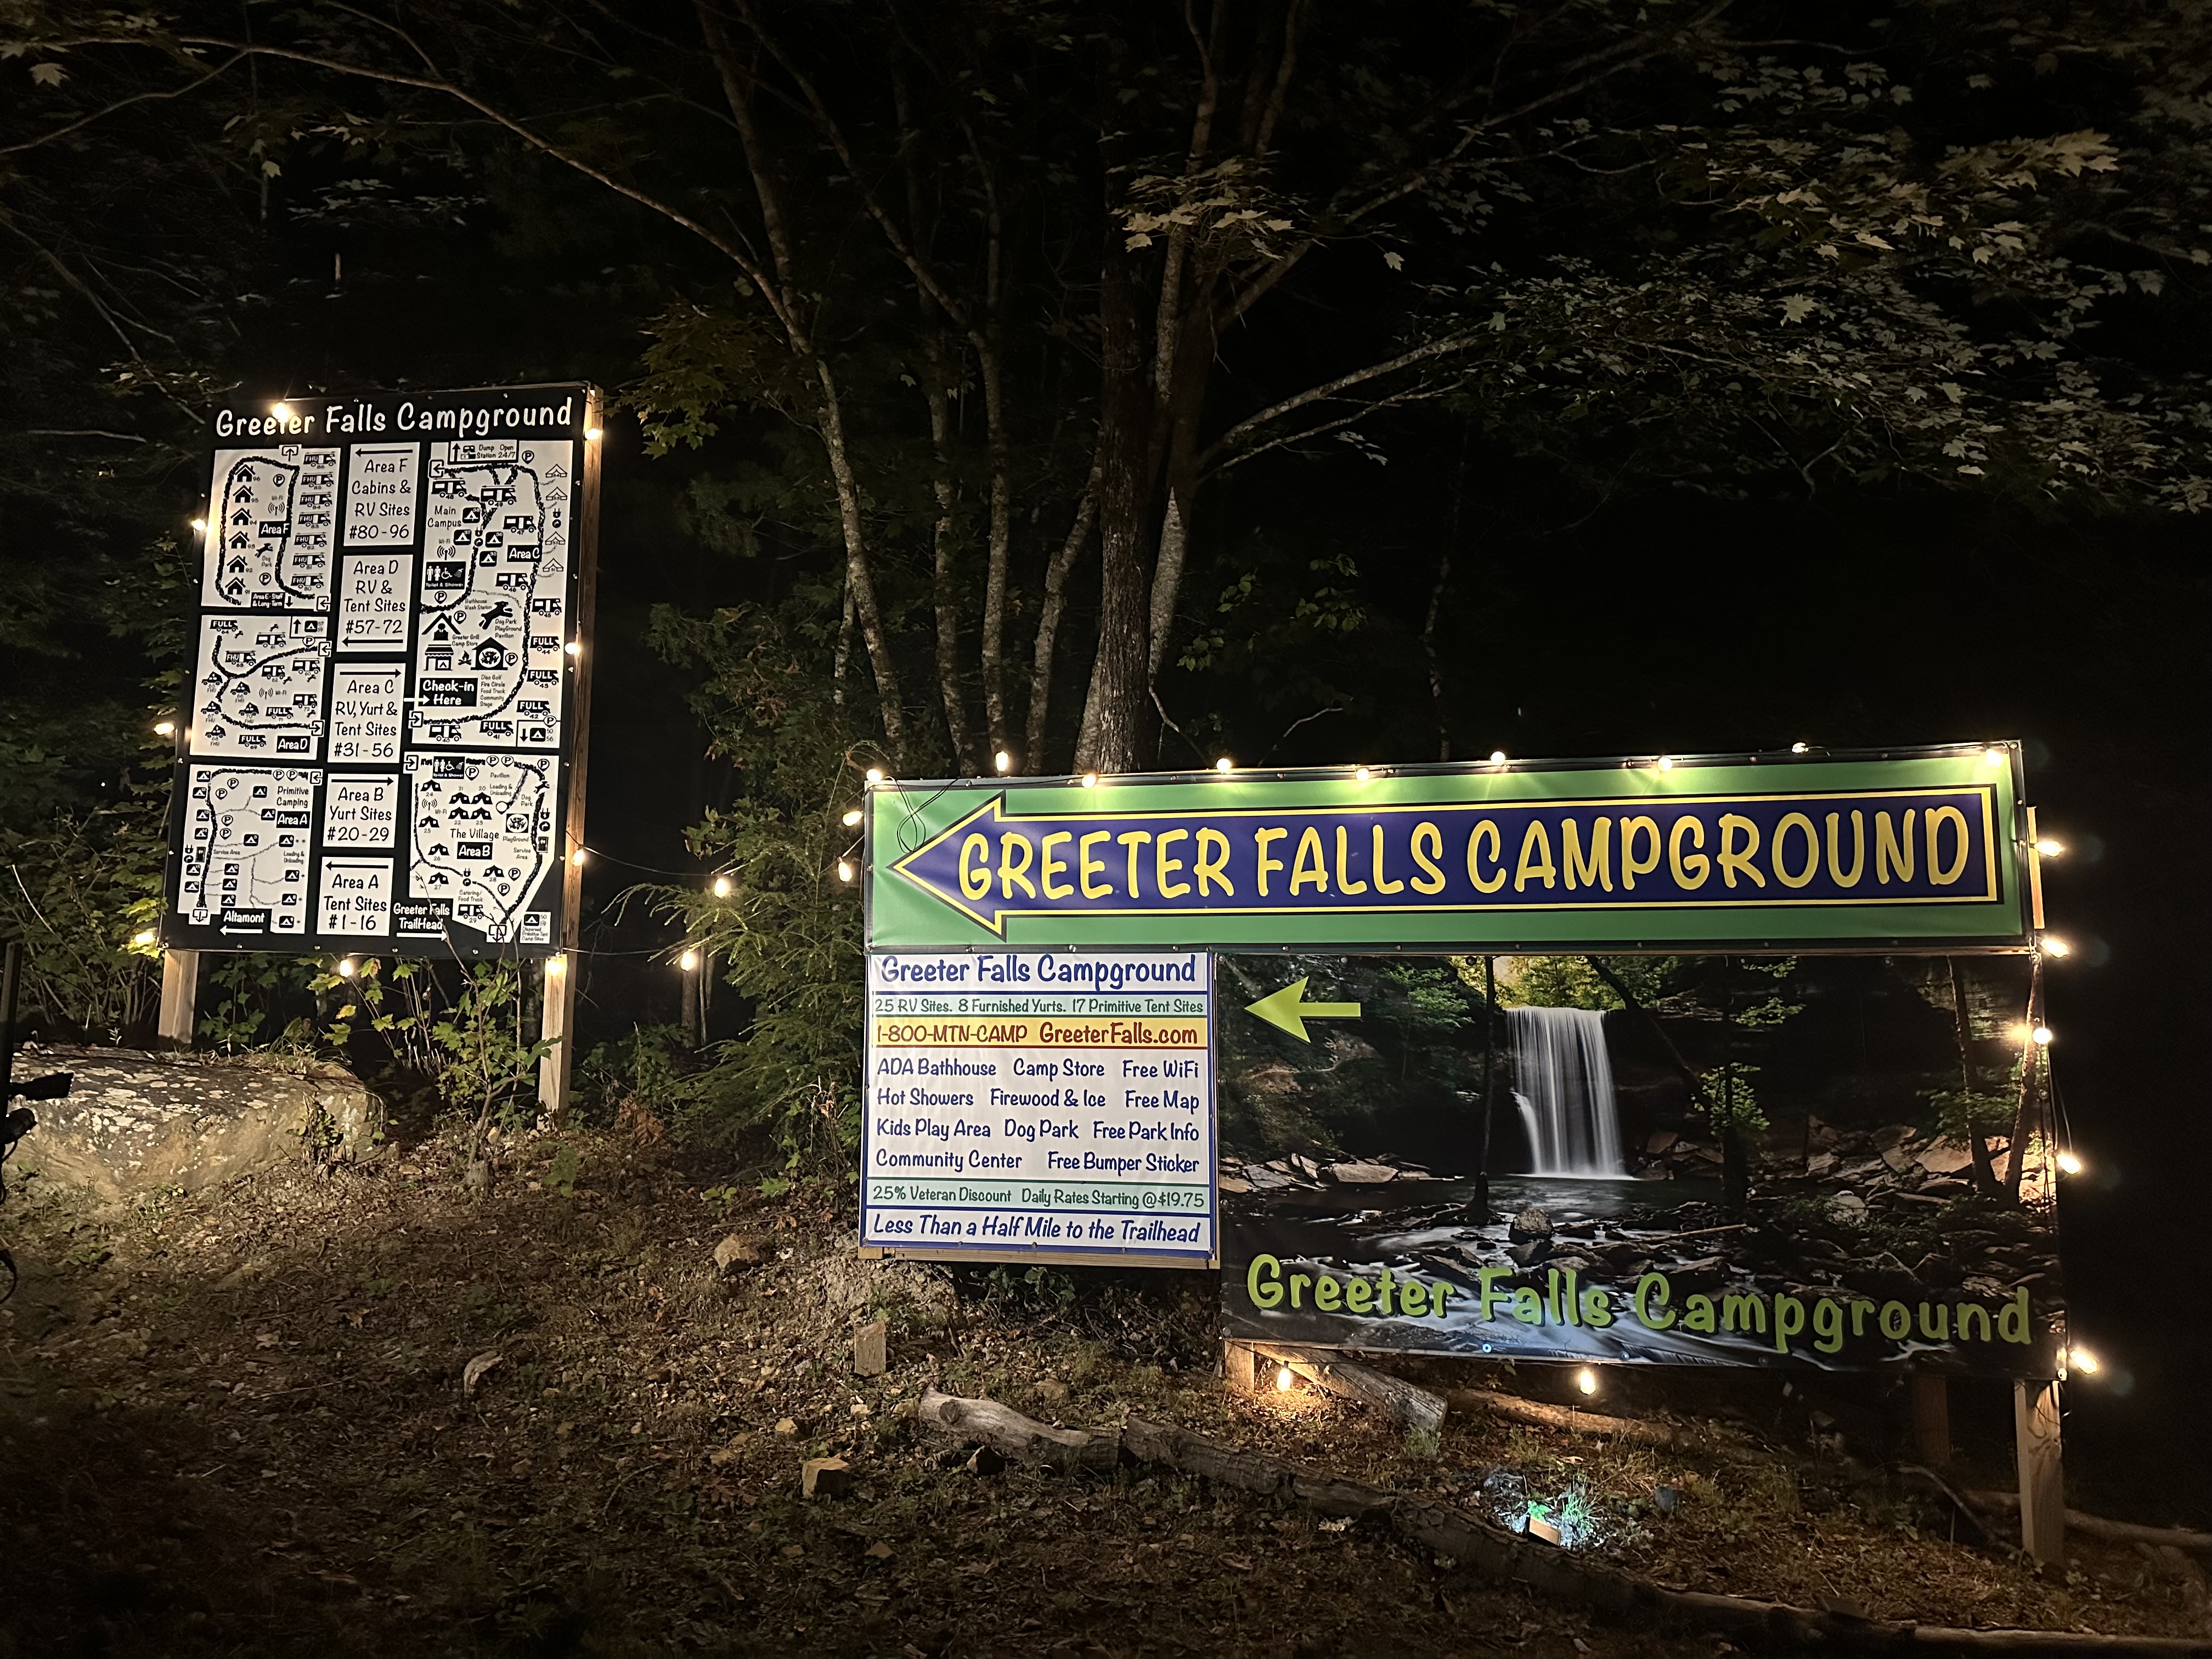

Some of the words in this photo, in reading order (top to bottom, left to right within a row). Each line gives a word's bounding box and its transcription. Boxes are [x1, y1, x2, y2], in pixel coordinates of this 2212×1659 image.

[326, 403, 386, 433] Falls
[397, 397, 572, 437] Campground
[364, 459, 394, 473] Area
[399, 458, 408, 472] F
[352, 479, 396, 494] Cabins
[400, 479, 411, 493] &
[354, 502, 375, 516] RV
[379, 502, 409, 516] Sites
[435, 505, 455, 515] Main
[261, 523, 281, 534] Area
[283, 523, 289, 534] F
[427, 518, 461, 530] Campus
[509, 548, 531, 558] Area
[532, 549, 540, 558] C
[353, 561, 384, 574] Area
[389, 560, 398, 574] D
[356, 579, 377, 594] RV
[381, 580, 392, 594] &
[344, 599, 370, 612] Tent
[374, 598, 405, 612] Sites
[347, 680, 379, 694] Area
[385, 679, 394, 693] C
[422, 680, 474, 692] Check-in
[433, 693, 462, 706] Here
[335, 701, 357, 718] RV,
[359, 702, 383, 715] Yurt
[386, 702, 397, 715] &
[335, 722, 362, 736] Tent
[365, 721, 397, 736] Sites
[278, 738, 298, 750] Area
[300, 738, 307, 749] D
[278, 786, 308, 794] Primitive
[338, 787, 369, 802] Area
[374, 787, 383, 801] B
[276, 797, 308, 808] Camping
[278, 814, 298, 825] Area
[300, 814, 307, 825] A
[330, 805, 356, 820] Yurt
[360, 806, 392, 820] Sites
[450, 828, 466, 838] The
[469, 828, 499, 841] Village
[459, 845, 481, 856] Area
[482, 845, 490, 856] B
[959, 827, 1234, 901] GREETER
[1255, 821, 1447, 897] FALLS
[1466, 805, 1970, 894] CAMPGROUND
[332, 873, 363, 889] Area
[368, 874, 379, 889] A
[324, 895, 351, 911] Tent
[355, 895, 387, 912] Sites
[393, 902, 427, 916] Greeter
[429, 903, 450, 916] Falls
[223, 910, 265, 923] Altamont
[399, 917, 443, 930] TrailHead
[881, 955, 970, 983] Greeter
[978, 954, 1030, 983] Falls
[1037, 953, 1195, 991] Campground
[875, 998, 894, 1012] 25
[898, 998, 918, 1012] RV
[921, 998, 952, 1012] Sites.
[958, 998, 969, 1012] 8
[972, 998, 1029, 1013] Furnished
[1032, 999, 1066, 1013] Yurts.
[1073, 998, 1086, 1013] 17
[1089, 998, 1142, 1013] Primitive
[1144, 999, 1170, 1012] Tent
[1173, 998, 1203, 1013] Sites
[877, 1024, 1028, 1042] 1-800-MTN-CAMP
[1039, 1022, 1198, 1044] GreeterFalls.com
[877, 1058, 913, 1075] ADA
[918, 1058, 996, 1076] Bathhouse
[1013, 1058, 1058, 1082] Camp
[1063, 1058, 1104, 1076] Store
[1122, 1059, 1158, 1077] Free
[1163, 1059, 1198, 1078] WiFi
[877, 1087, 905, 1105] Hot
[910, 1087, 974, 1105] Showers
[990, 1088, 1059, 1107] Firewood
[1064, 1088, 1079, 1107] &
[1084, 1089, 1105, 1107] Ice
[1125, 1090, 1159, 1108] Free
[1163, 1090, 1199, 1115] Map
[877, 1118, 911, 1136] Kids
[915, 1118, 949, 1141] Play
[953, 1119, 991, 1137] Area
[1005, 1119, 1035, 1142] Dog
[1040, 1119, 1079, 1139] Park
[1093, 1120, 1125, 1139] Free
[1129, 1121, 1167, 1141] Park
[1171, 1122, 1199, 1141] Info
[876, 1148, 963, 1172] Community
[968, 1149, 1022, 1169] Center
[1048, 1151, 1080, 1169] Free
[1084, 1152, 1142, 1177] Bumper
[1146, 1153, 1200, 1173] Sticker
[873, 1186, 906, 1200] 25%
[910, 1186, 956, 1201] Veteran
[960, 1187, 1012, 1202] Discount
[1022, 1188, 1051, 1207] Daily
[1053, 1188, 1089, 1204] Rates
[1092, 1189, 1139, 1209] Starting
[873, 1213, 913, 1234] Less
[919, 1214, 962, 1235] Than
[966, 1222, 977, 1236] a
[982, 1215, 1024, 1237] Half
[1024, 1216, 1061, 1238] Mile
[1066, 1221, 1083, 1239] to
[1088, 1218, 1115, 1239] the
[1121, 1220, 1201, 1243] Trailhead
[1248, 1254, 1456, 1318] Greeter
[1479, 1266, 1615, 1328] Falls
[1635, 1272, 2032, 1355] Campground
